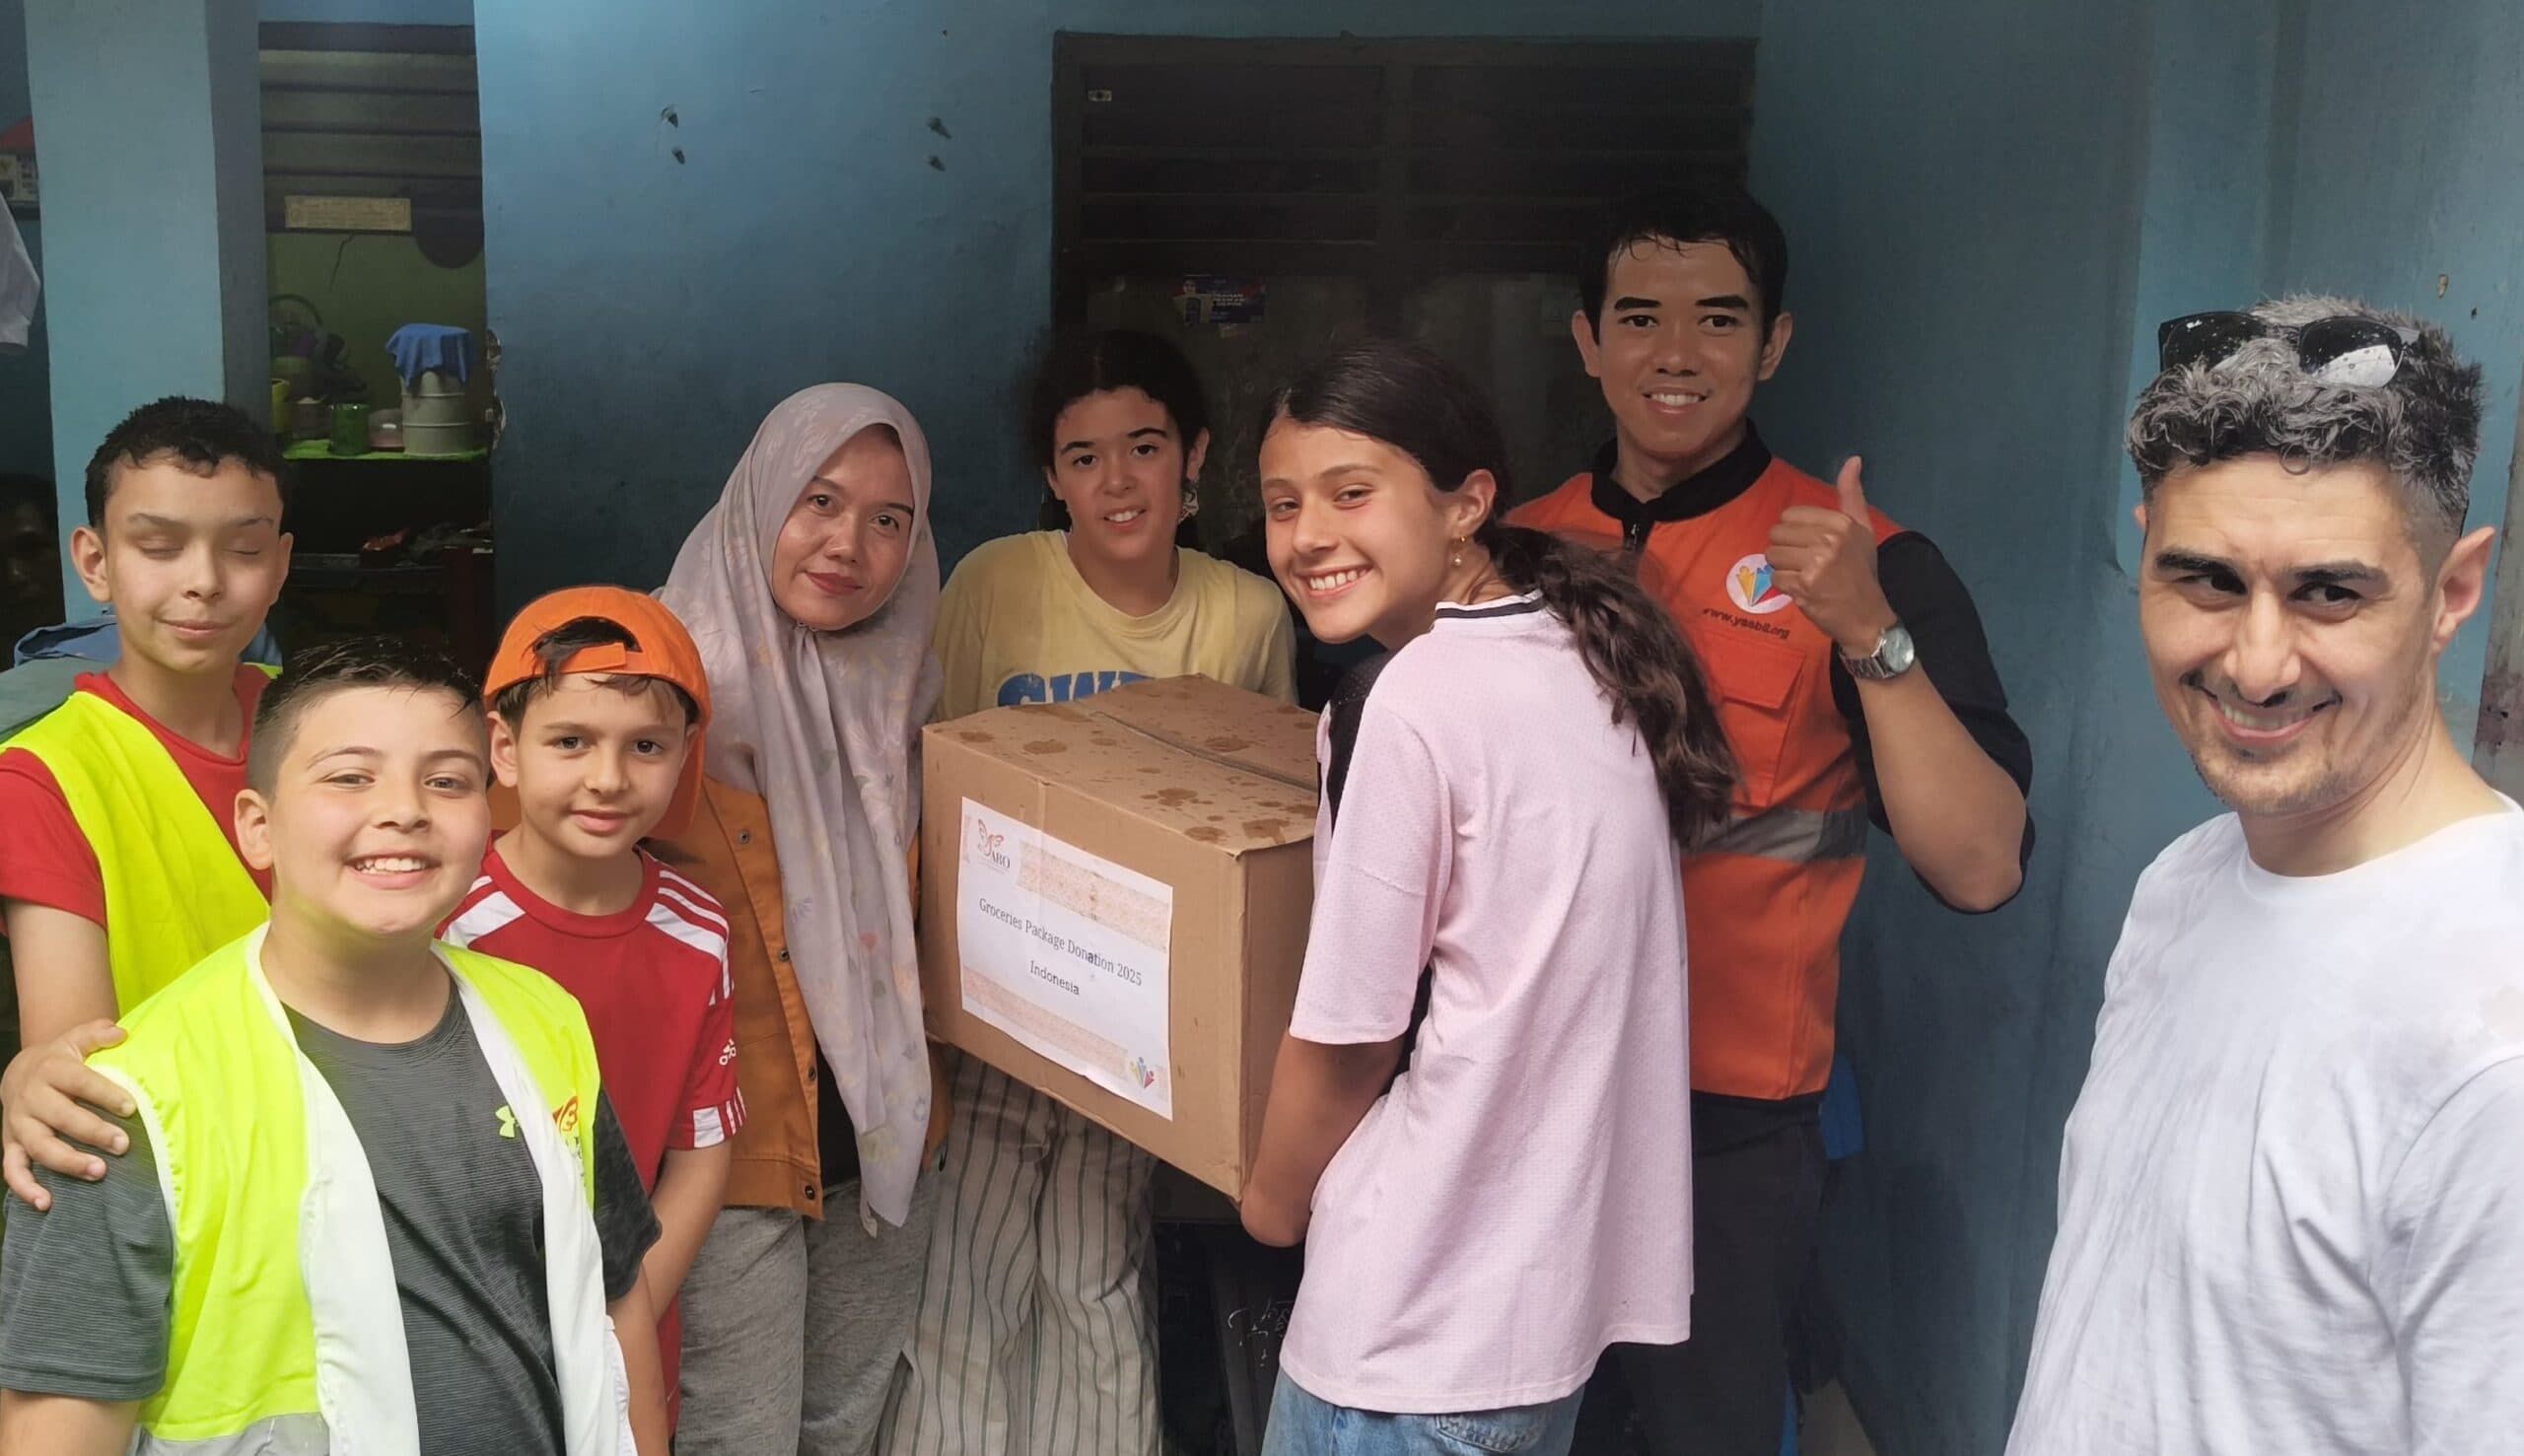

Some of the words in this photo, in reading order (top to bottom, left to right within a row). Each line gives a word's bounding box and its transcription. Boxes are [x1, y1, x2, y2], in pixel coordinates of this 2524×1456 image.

[979, 897, 1022, 931] Groceries
[1025, 919, 1065, 950] Package
[1067, 938, 1114, 974] Donation
[1116, 962, 1143, 987] 2025
[1029, 959, 1081, 996] Indonesia
